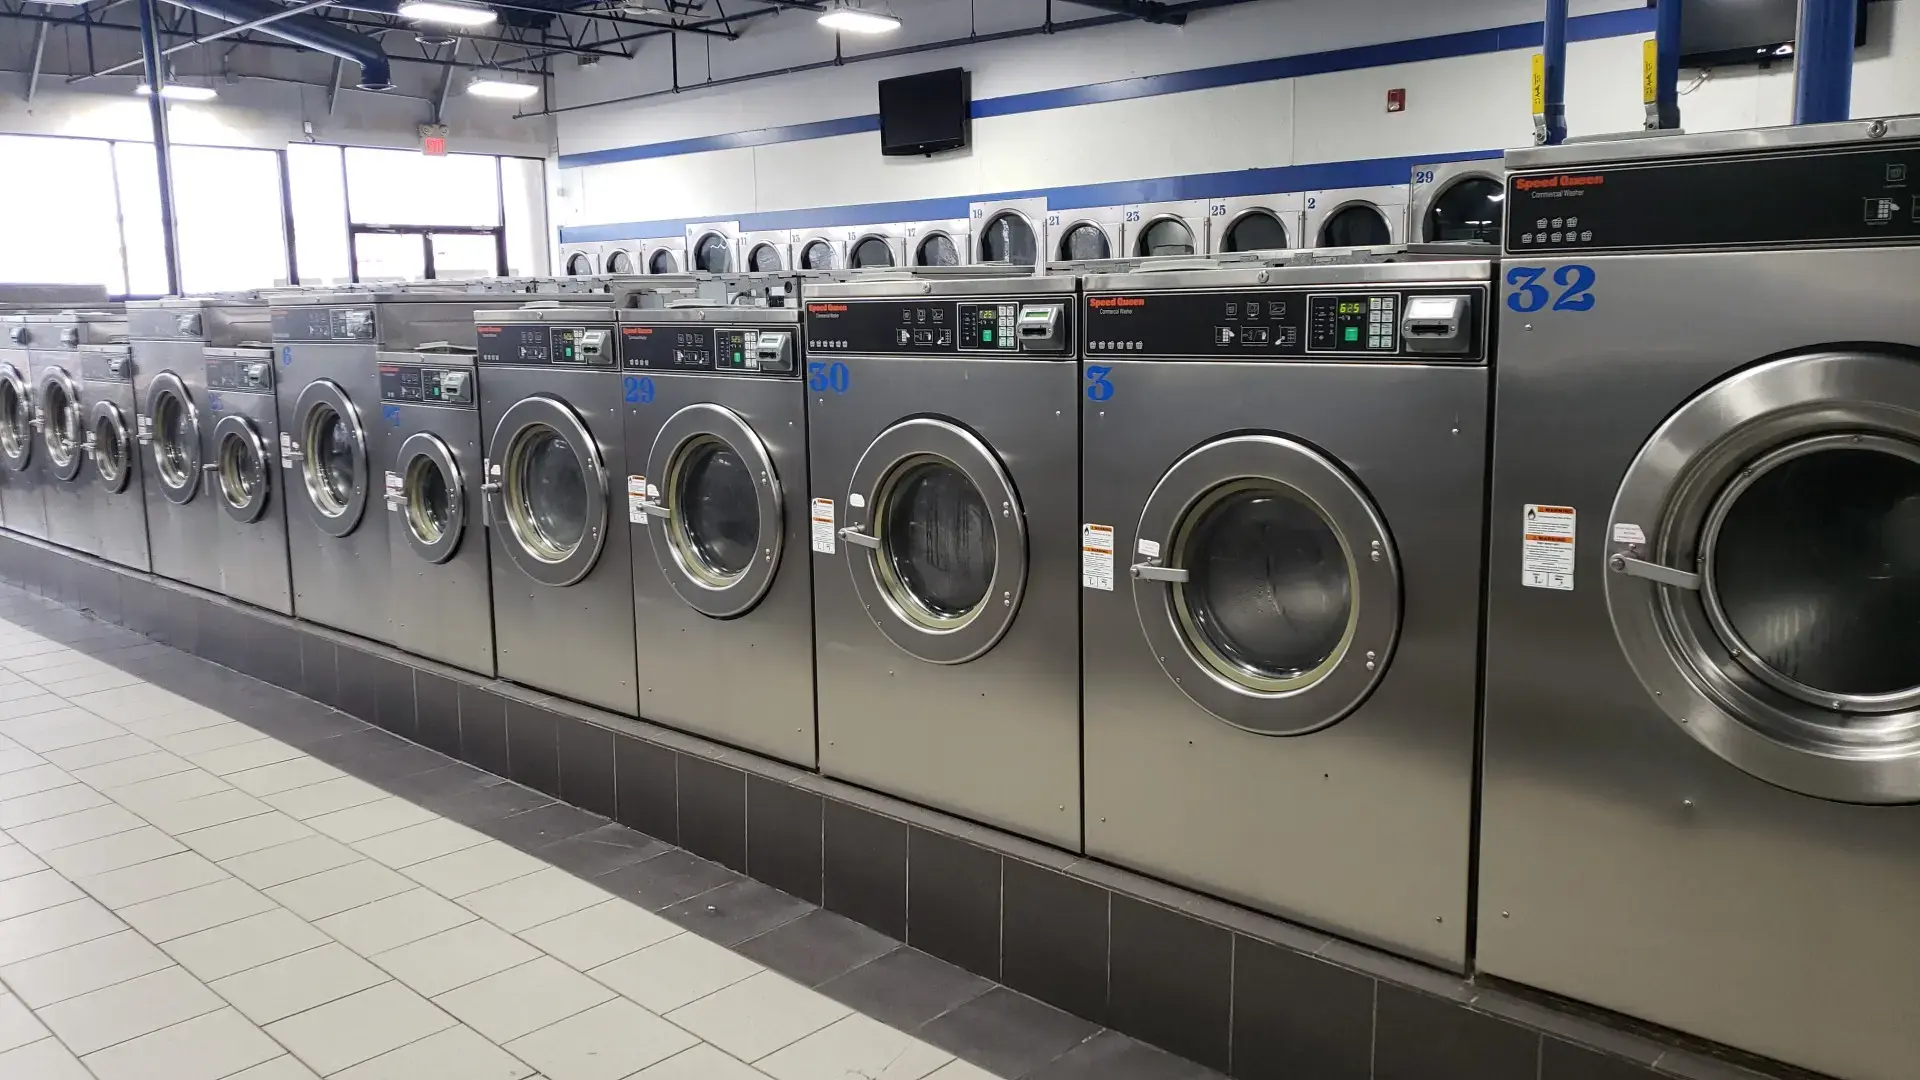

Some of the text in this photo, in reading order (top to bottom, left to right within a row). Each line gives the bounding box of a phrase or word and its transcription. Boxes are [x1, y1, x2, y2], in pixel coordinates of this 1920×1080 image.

[1416, 171, 1433, 183] 29
[1515, 176, 1604, 191] Speed Queen
[1532, 189, 1585, 199] Commercial Washer
[1308, 198, 1316, 210] 2
[973, 209, 983, 219] 19
[1211, 205, 1226, 216] 25
[1049, 216, 1059, 226] 21
[1126, 211, 1140, 222] 23
[907, 228, 916, 237] 17
[1506, 264, 1596, 313] 32
[1090, 297, 1145, 308] Speed Queen
[808, 362, 849, 393] 30
[1086, 365, 1114, 402] 3
[624, 376, 655, 404] 29
